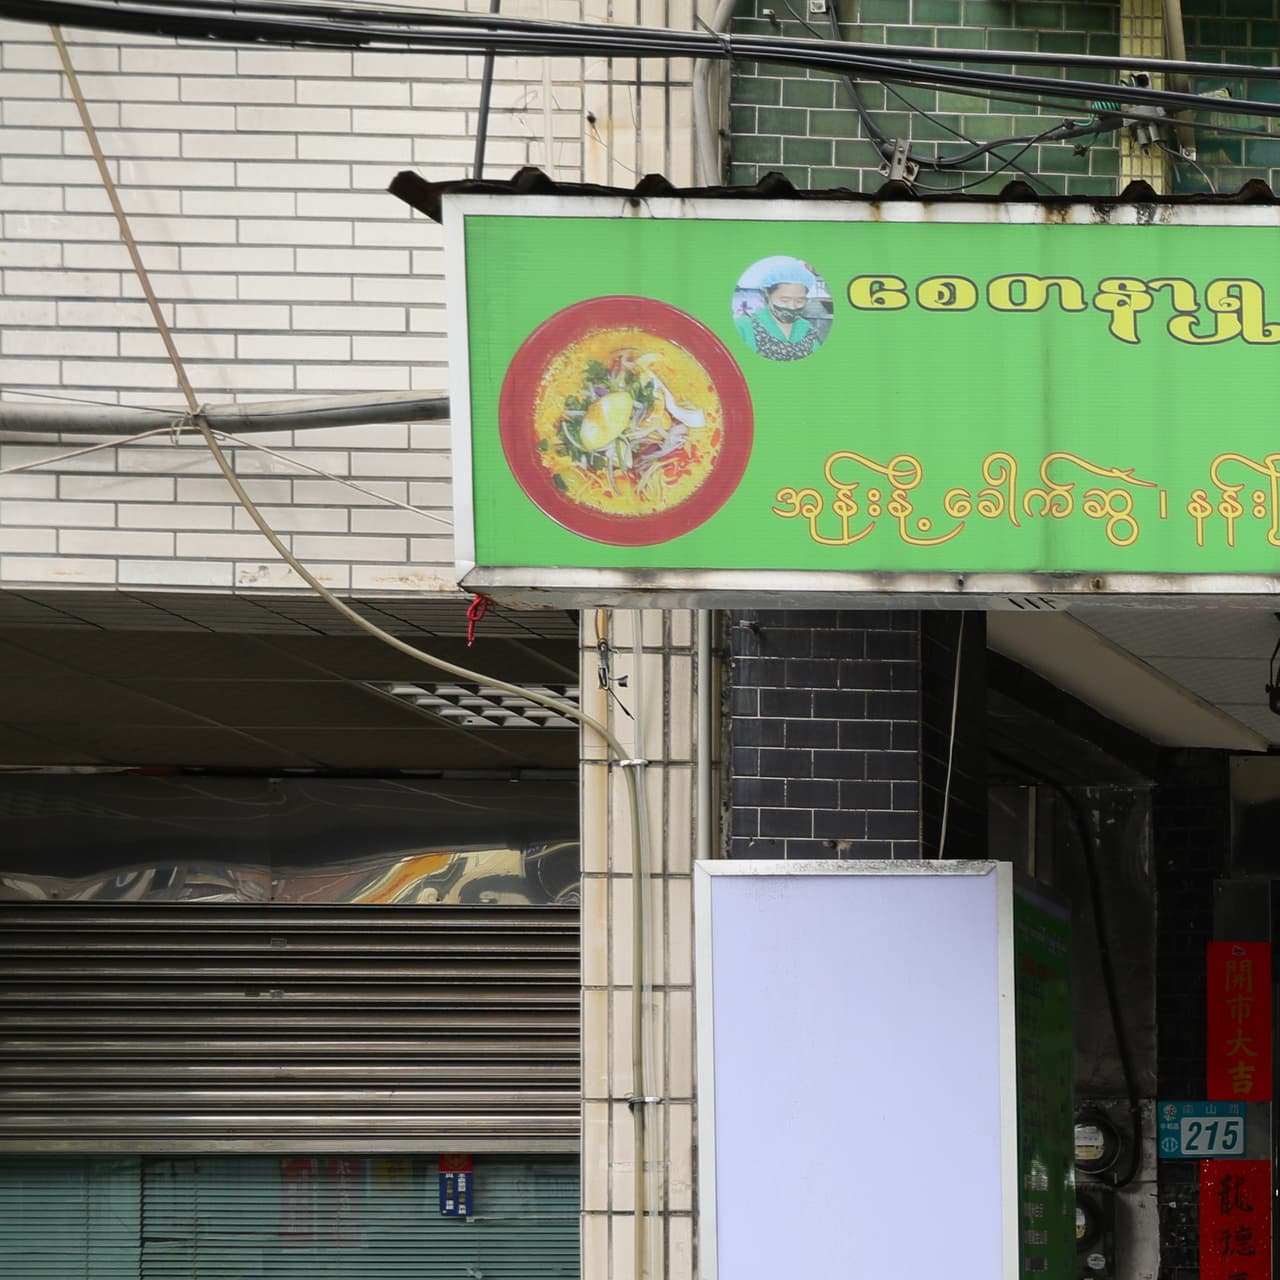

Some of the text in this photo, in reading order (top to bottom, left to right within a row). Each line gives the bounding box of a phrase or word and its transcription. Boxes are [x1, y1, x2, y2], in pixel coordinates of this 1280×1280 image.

[1222, 957, 1260, 1096] 開市大吉
[1185, 1121, 1240, 1151] 215
